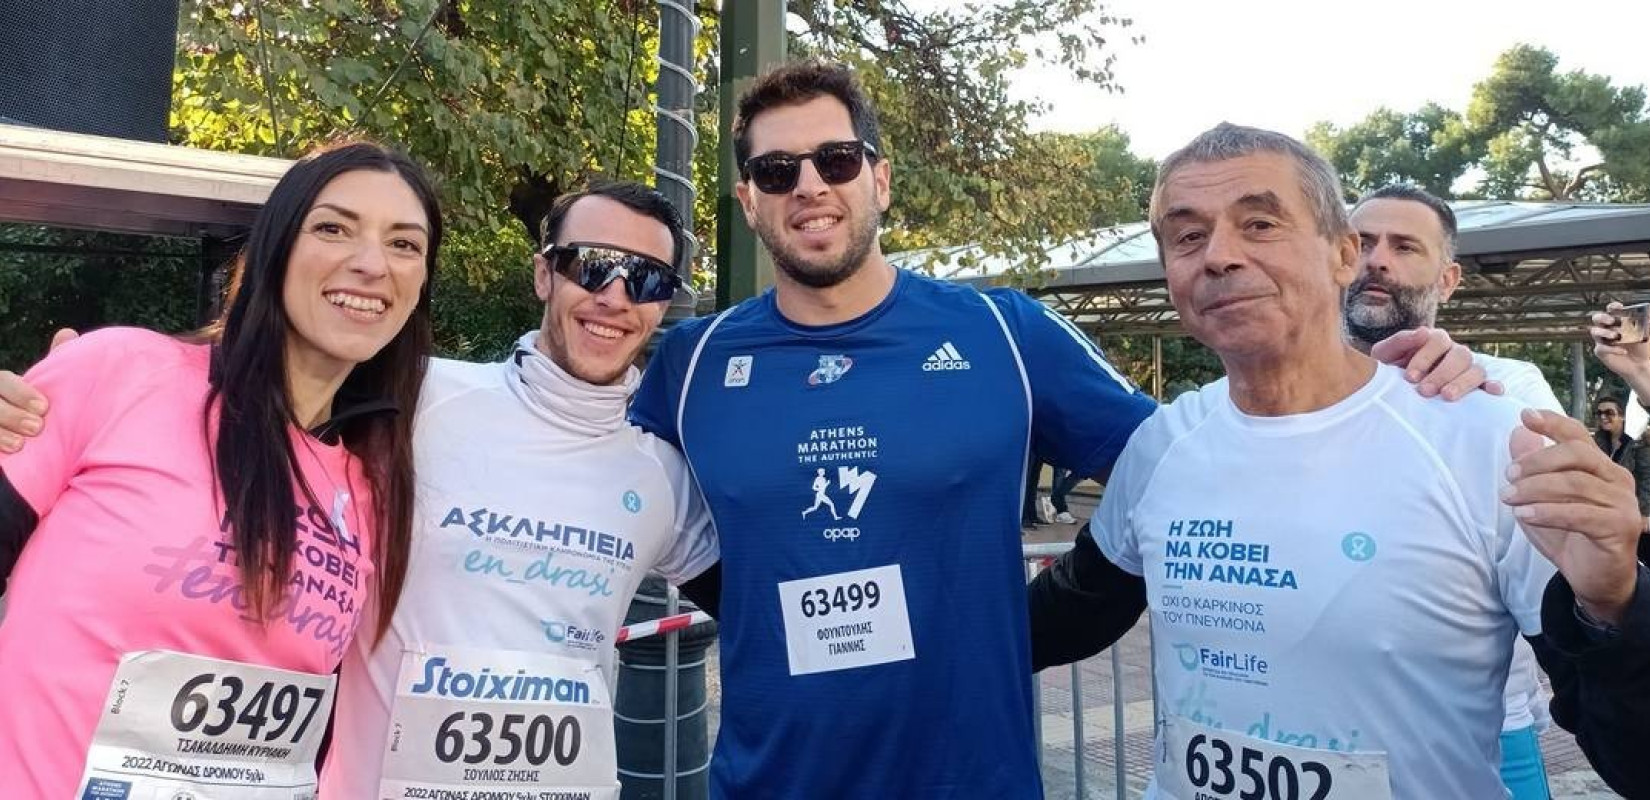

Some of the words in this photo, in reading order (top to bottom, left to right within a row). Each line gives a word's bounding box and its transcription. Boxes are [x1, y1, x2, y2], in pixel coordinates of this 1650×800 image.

[922, 359, 971, 372] adidas
[810, 425, 864, 440] ATHENS
[797, 437, 878, 454] MARATHON
[798, 455, 818, 463] THE
[821, 450, 878, 462] AUTHENTIC
[439, 506, 636, 561] ΑΣΚΛΗΠΙΕΙΑ
[822, 527, 861, 542] opap
[1168, 520, 1184, 537] Η
[1187, 519, 1233, 538] ΖΩΗ
[1165, 540, 1192, 558] ΝΑ
[1197, 541, 1270, 563] ΚΟΒΕΙ
[463, 549, 614, 597] en_drasi
[1164, 562, 1204, 581] ΤΗΝ
[1208, 564, 1298, 590] ΑΝΑΣΑ
[801, 580, 881, 618] 63499
[1162, 595, 1179, 608] ΟΧΙ
[1193, 597, 1265, 616] ΚΑΡΚΙΝΟΣ
[816, 621, 873, 641] ΦΟΥΝΤΟΥΛΗΣ
[1162, 611, 1184, 624] ΤΟΥ
[1185, 613, 1266, 633] ΠΝΕΥΜΟΝΑ
[828, 639, 866, 656] ΓΙΑΝΝΗΣ
[1200, 648, 1269, 674] FairLife
[411, 656, 590, 704] Stoiximan
[111, 686, 127, 715] Block
[170, 673, 326, 744] 63497
[435, 711, 582, 766] 63500
[121, 755, 152, 770] 2022
[152, 758, 202, 778] ΑΓΩΝΑΣ
[202, 766, 246, 780] ΔΡΟΜΟΥ
[463, 768, 506, 782] ΣΟΥΛΙΟΣ
[507, 769, 541, 782] ΖΗΣΗΣ
[1186, 733, 1332, 800] 63502
[404, 787, 428, 799] 2022
